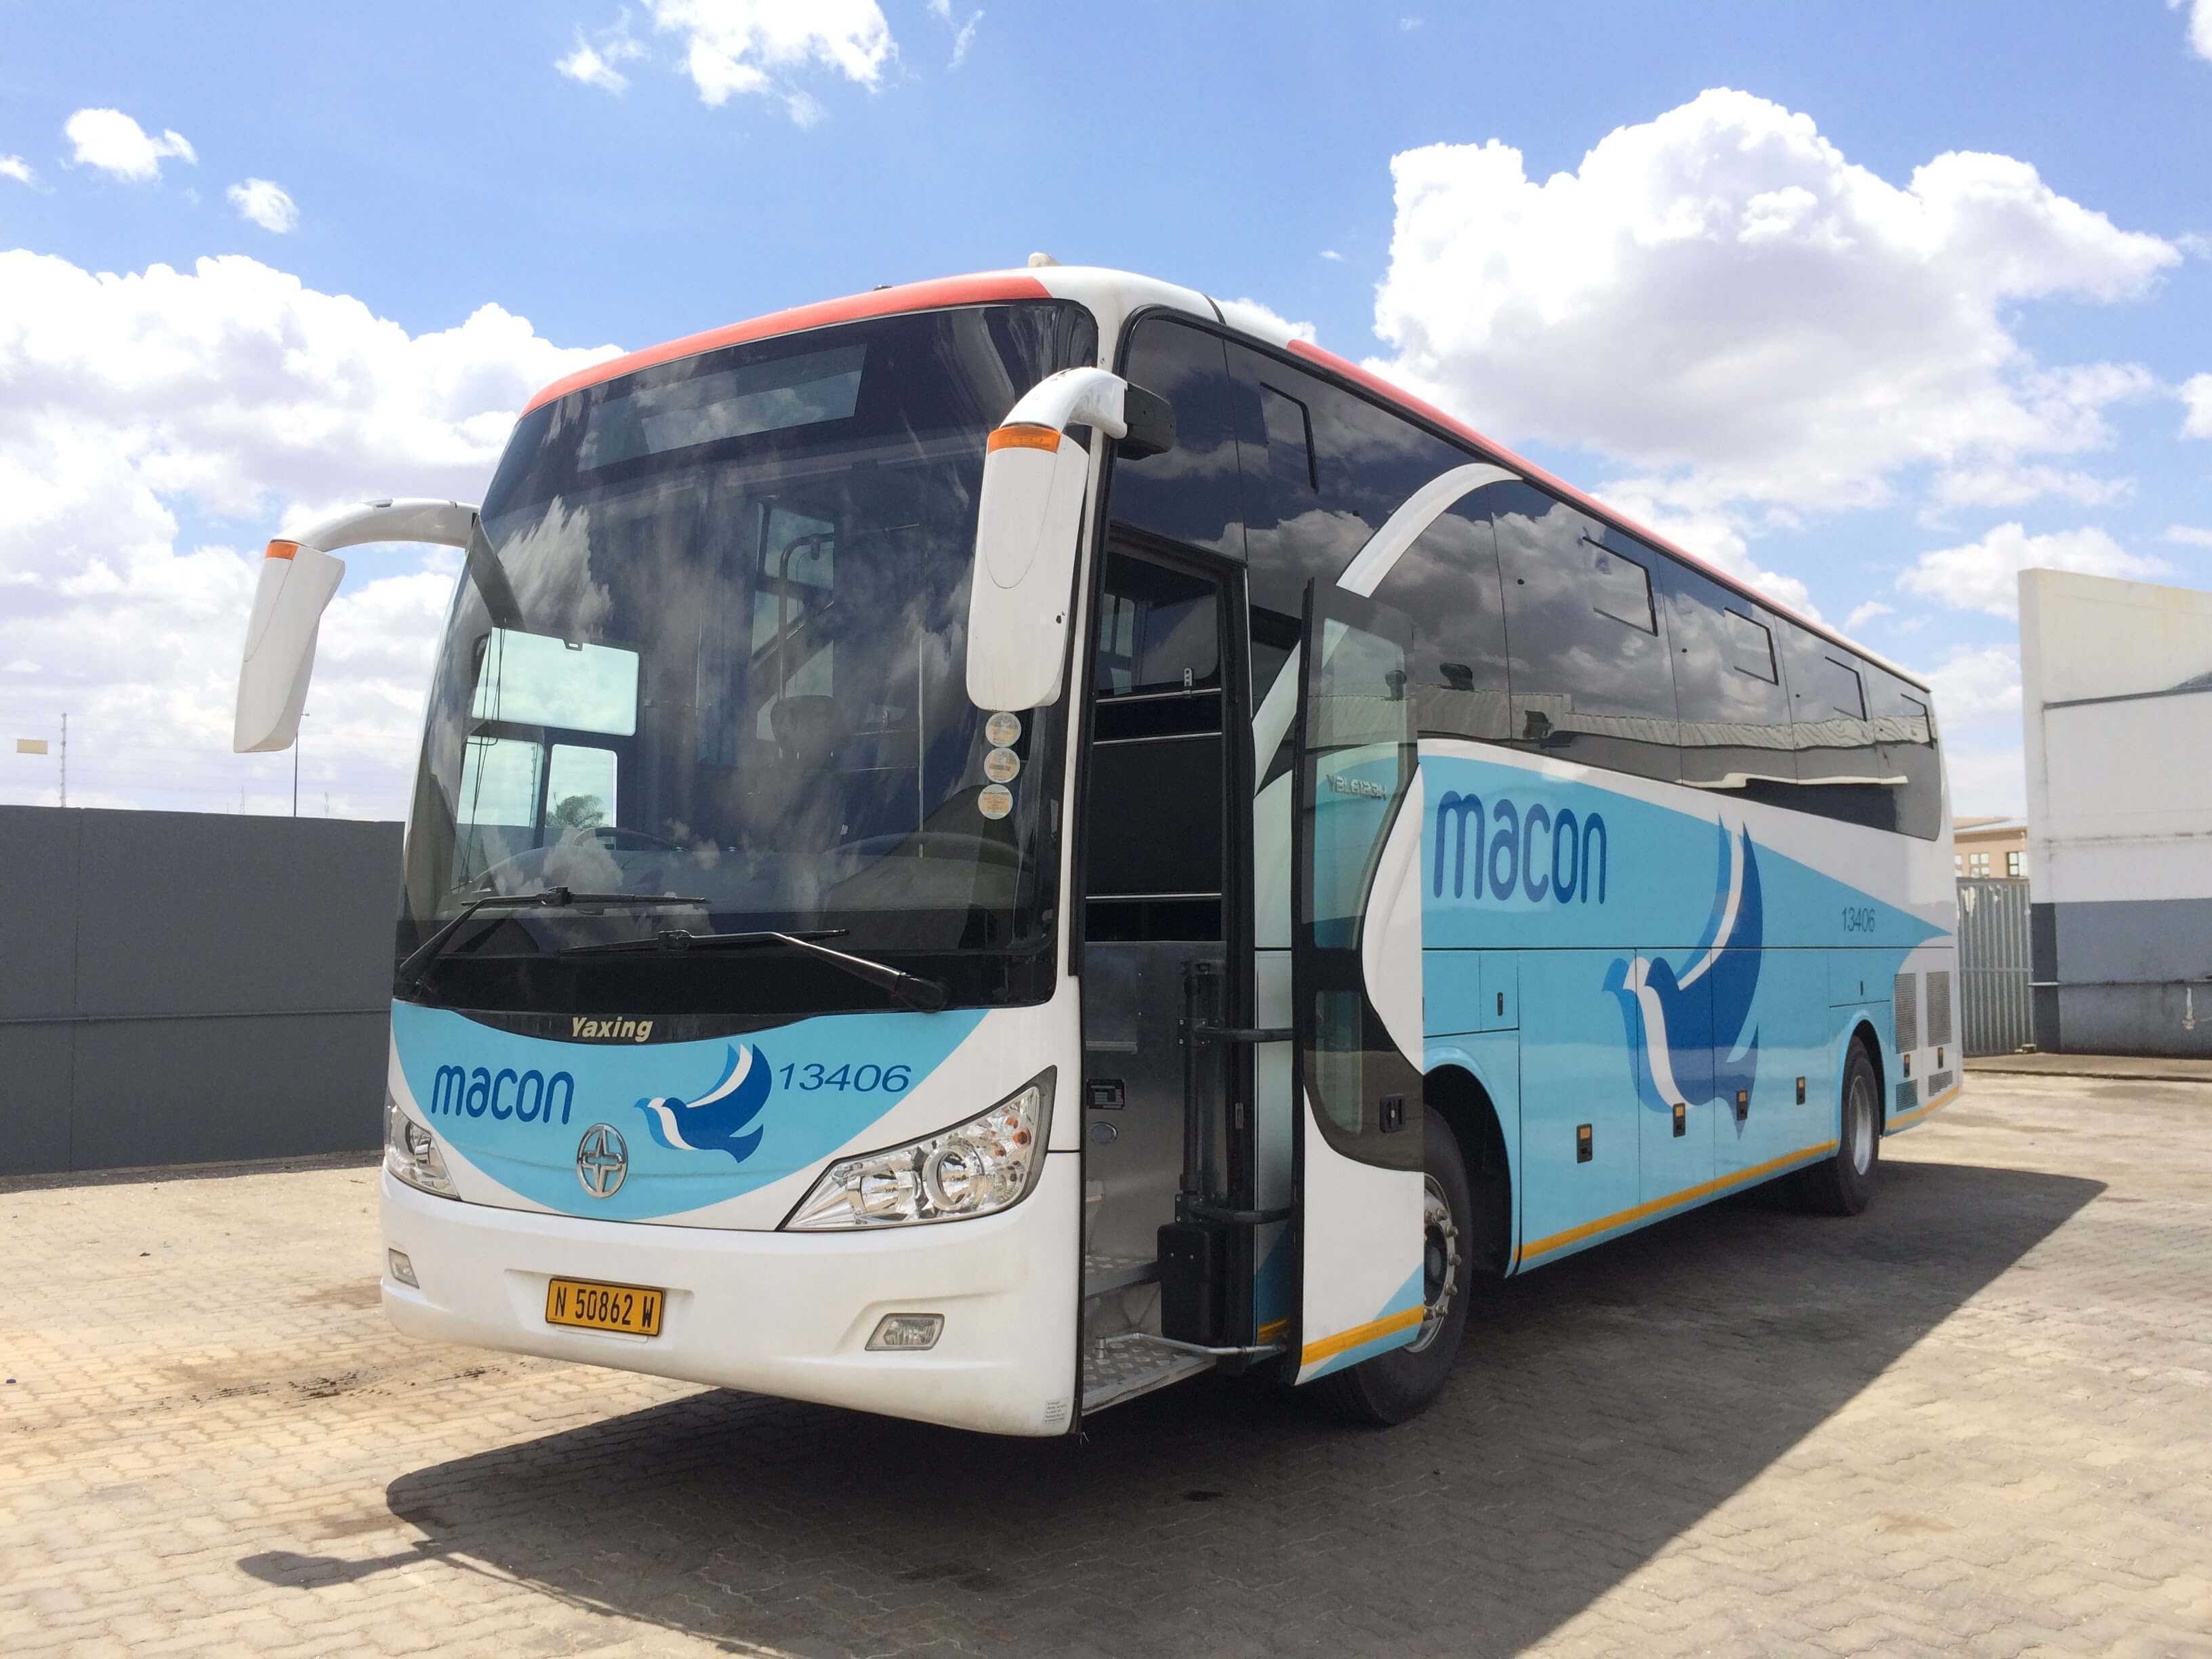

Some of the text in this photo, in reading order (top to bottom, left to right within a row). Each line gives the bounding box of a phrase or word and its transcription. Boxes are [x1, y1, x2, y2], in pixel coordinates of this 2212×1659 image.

[1433, 790, 1606, 904] macon
[1842, 907, 1875, 933] 13406
[572, 1017, 653, 1042] Yaxing
[431, 1065, 574, 1125] macon
[779, 1063, 912, 1092] 13406
[555, 1286, 654, 1328] N 50862 W
